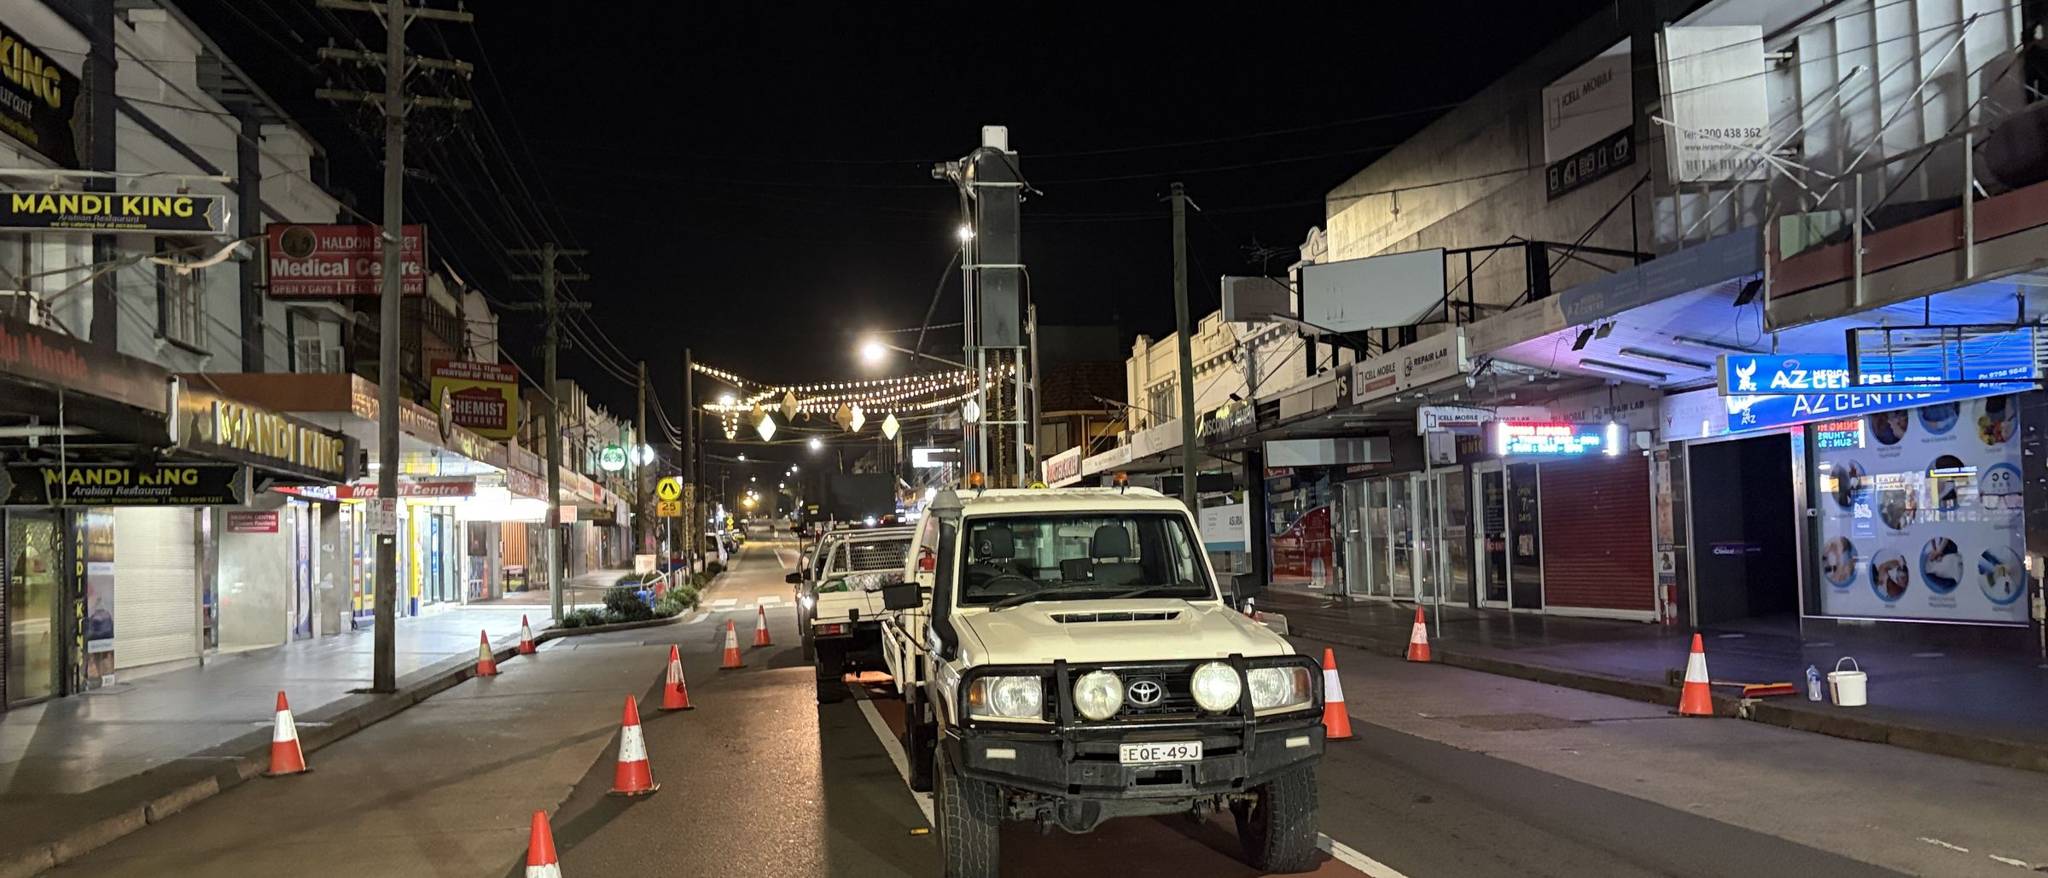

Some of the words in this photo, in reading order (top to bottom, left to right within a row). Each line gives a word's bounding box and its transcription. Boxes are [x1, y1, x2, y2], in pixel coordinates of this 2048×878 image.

[1724, 128, 1741, 138] 438
[1744, 127, 1761, 138] 362
[12, 193, 111, 214] MANDI
[122, 196, 193, 217] KING
[271, 258, 349, 277] Medical
[356, 258, 421, 276] Cere
[1435, 348, 1448, 359] LAB
[1770, 370, 1808, 389] AZ
[216, 400, 296, 462] MANDI
[300, 428, 345, 478] KING
[47, 468, 129, 485] MANDI
[412, 484, 459, 496] Centre
